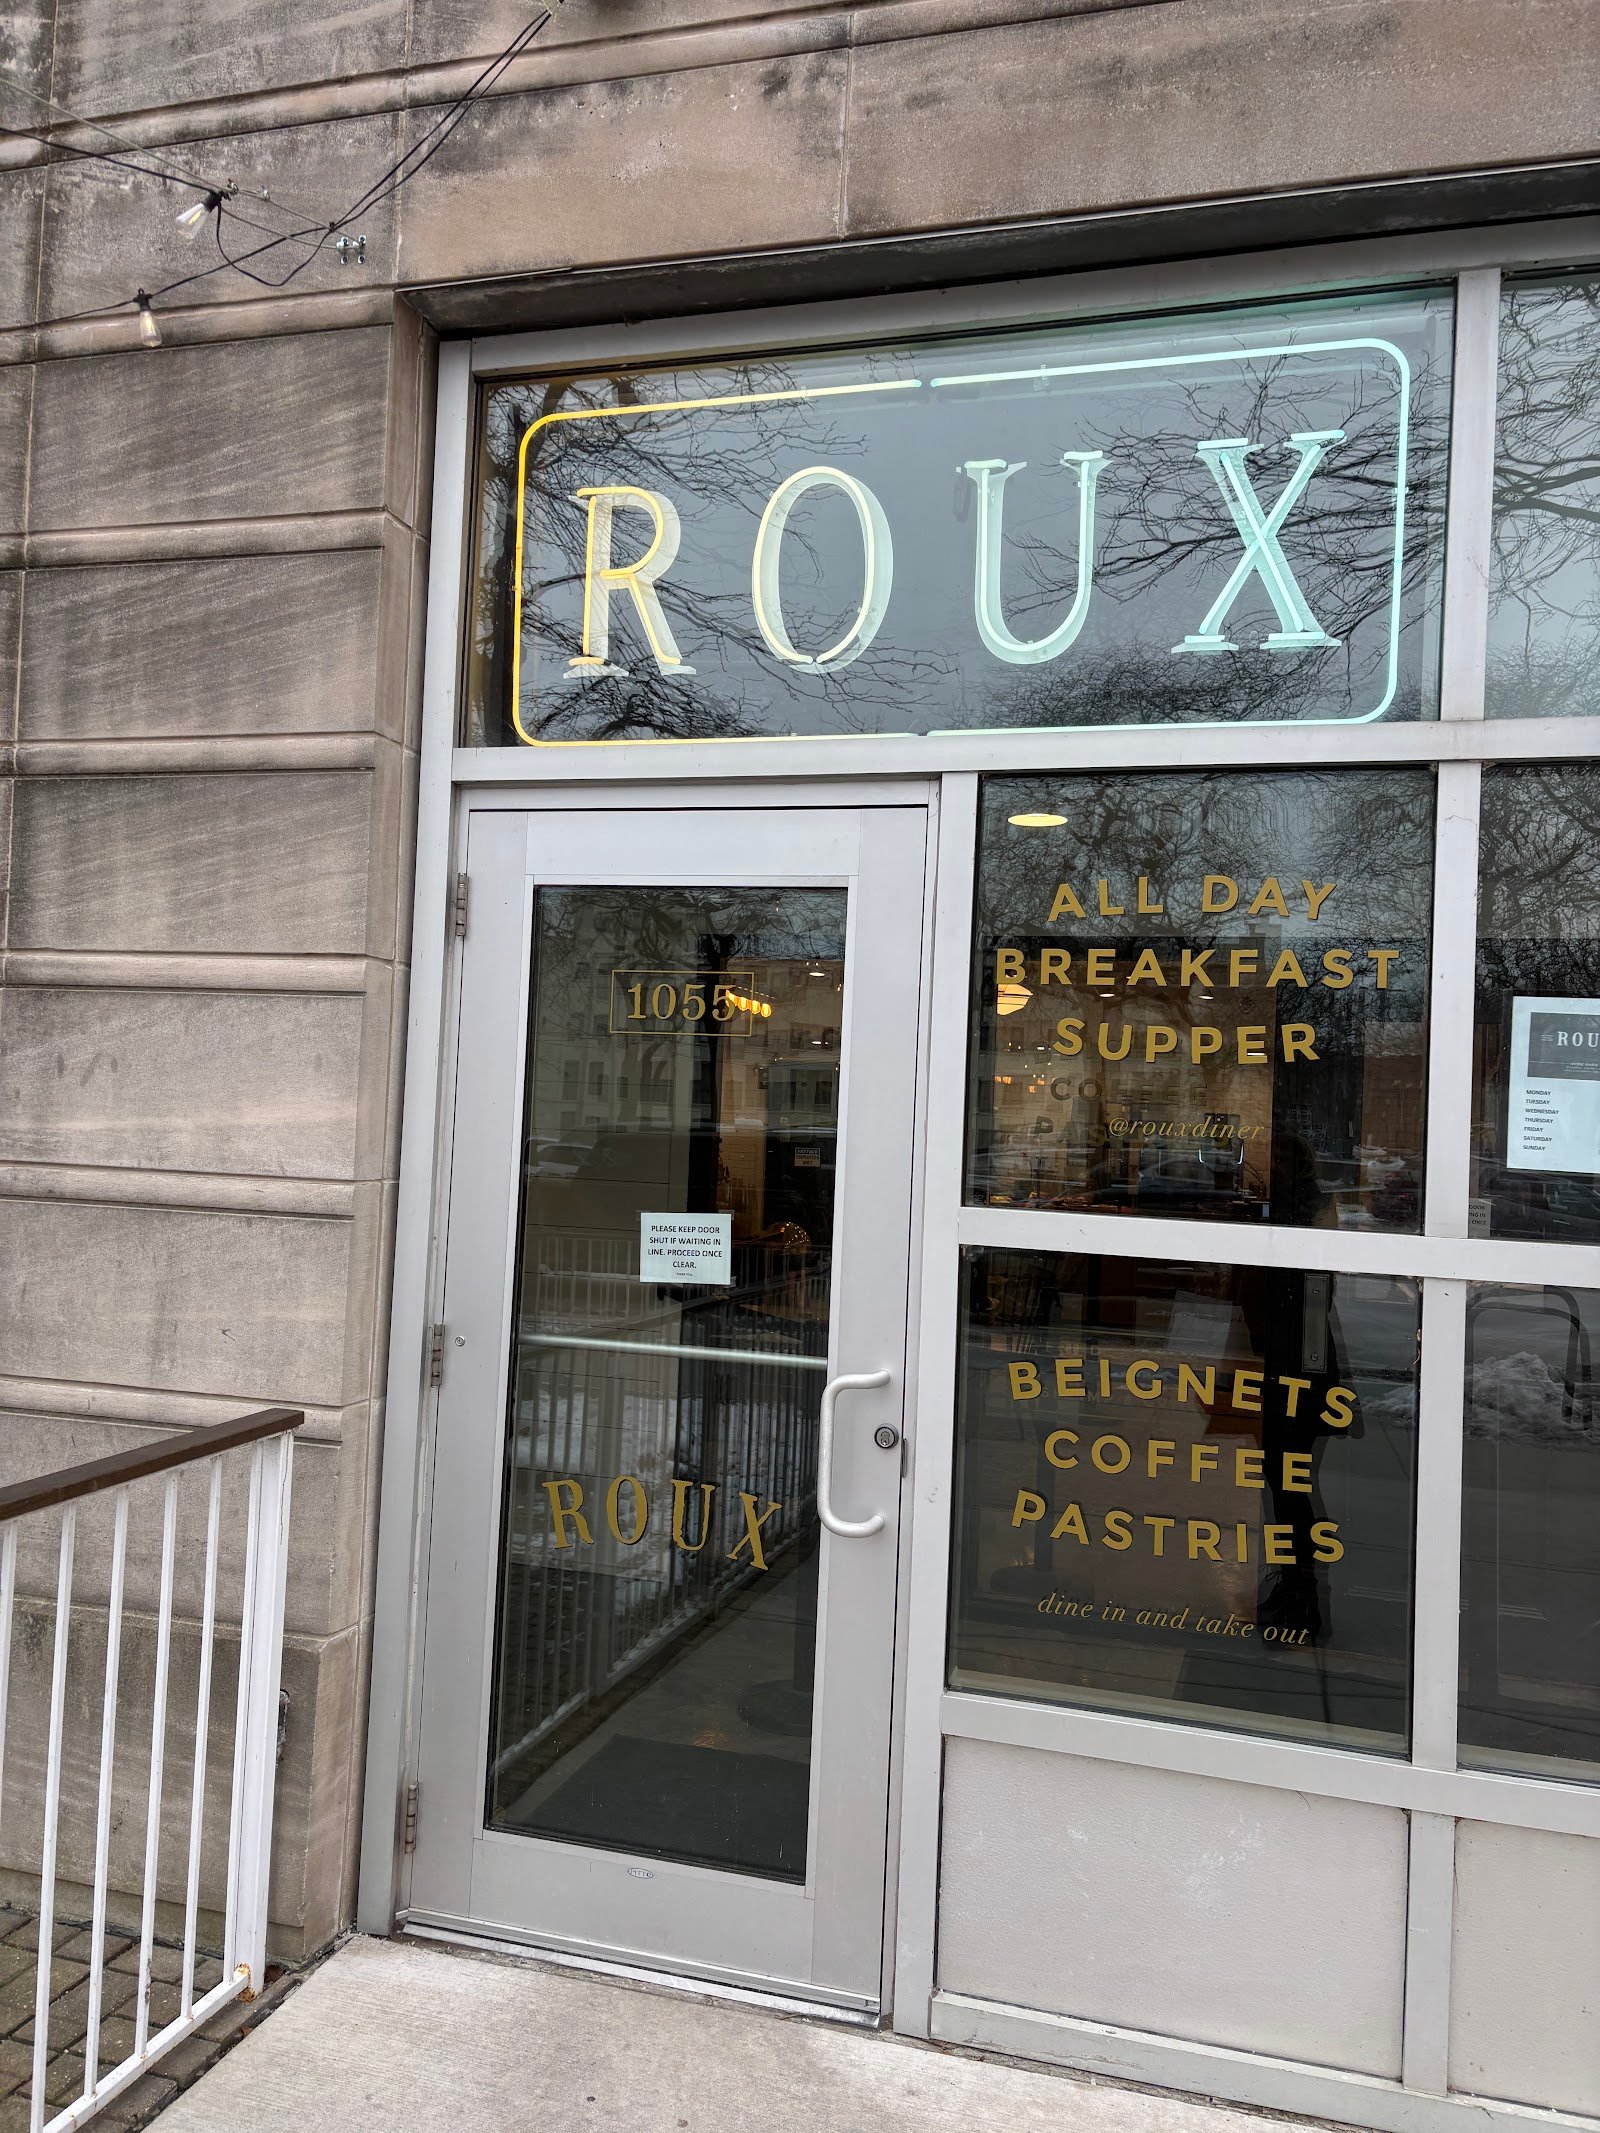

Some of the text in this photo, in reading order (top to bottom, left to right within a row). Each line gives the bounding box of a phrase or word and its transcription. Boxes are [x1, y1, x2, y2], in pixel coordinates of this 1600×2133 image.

[563, 430, 1347, 678] ROUX
[1048, 875, 1337, 922] ALL DAY
[997, 948, 1400, 989] BREAKFAST
[627, 983, 736, 1021] 1055
[1053, 1017, 1320, 1065] SUPPER
[1109, 1115, 1265, 1141] @rouxdiner
[651, 1225, 677, 1233] PLEASE
[698, 1226, 720, 1234] DOOR
[667, 1249, 700, 1257] PROCEED
[713, 1238, 721, 1246] IN
[672, 1261, 697, 1269] CLEAR.
[1008, 1358, 1358, 1428] BEIGNETS
[1044, 1429, 1314, 1493] COFFEE
[542, 1475, 782, 1571] ROUX
[1011, 1489, 1345, 1565] PASTRIES
[1037, 1592, 1310, 1646] dine in and take out
